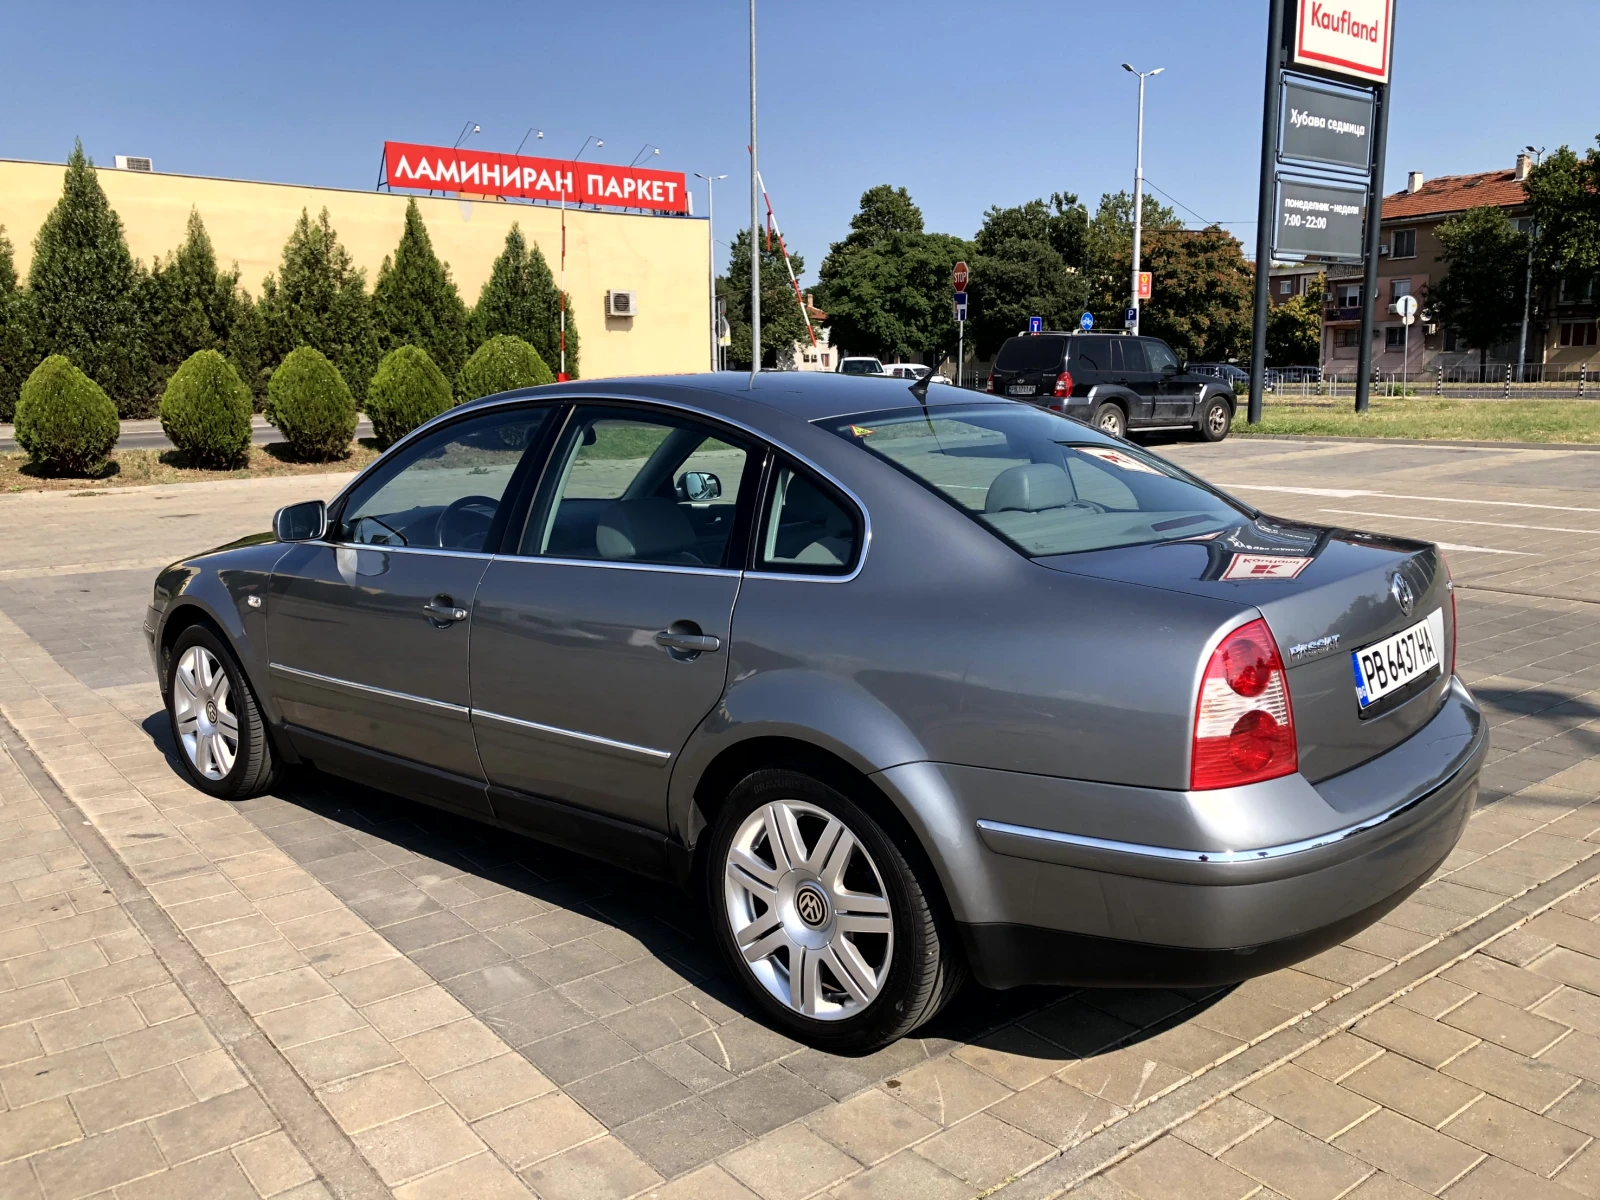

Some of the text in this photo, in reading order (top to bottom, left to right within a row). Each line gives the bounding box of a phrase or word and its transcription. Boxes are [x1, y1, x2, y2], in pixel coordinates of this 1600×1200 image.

[1311, 1, 1378, 43] Kaufland
[1290, 108, 1366, 137] Хубава седмица
[394, 154, 678, 202] ЛАМИНИРАН ПАРКЕТ
[954, 271, 967, 283] STOP
[1127, 309, 1135, 320] P
[1361, 626, 1436, 695] PB 6437 HA
